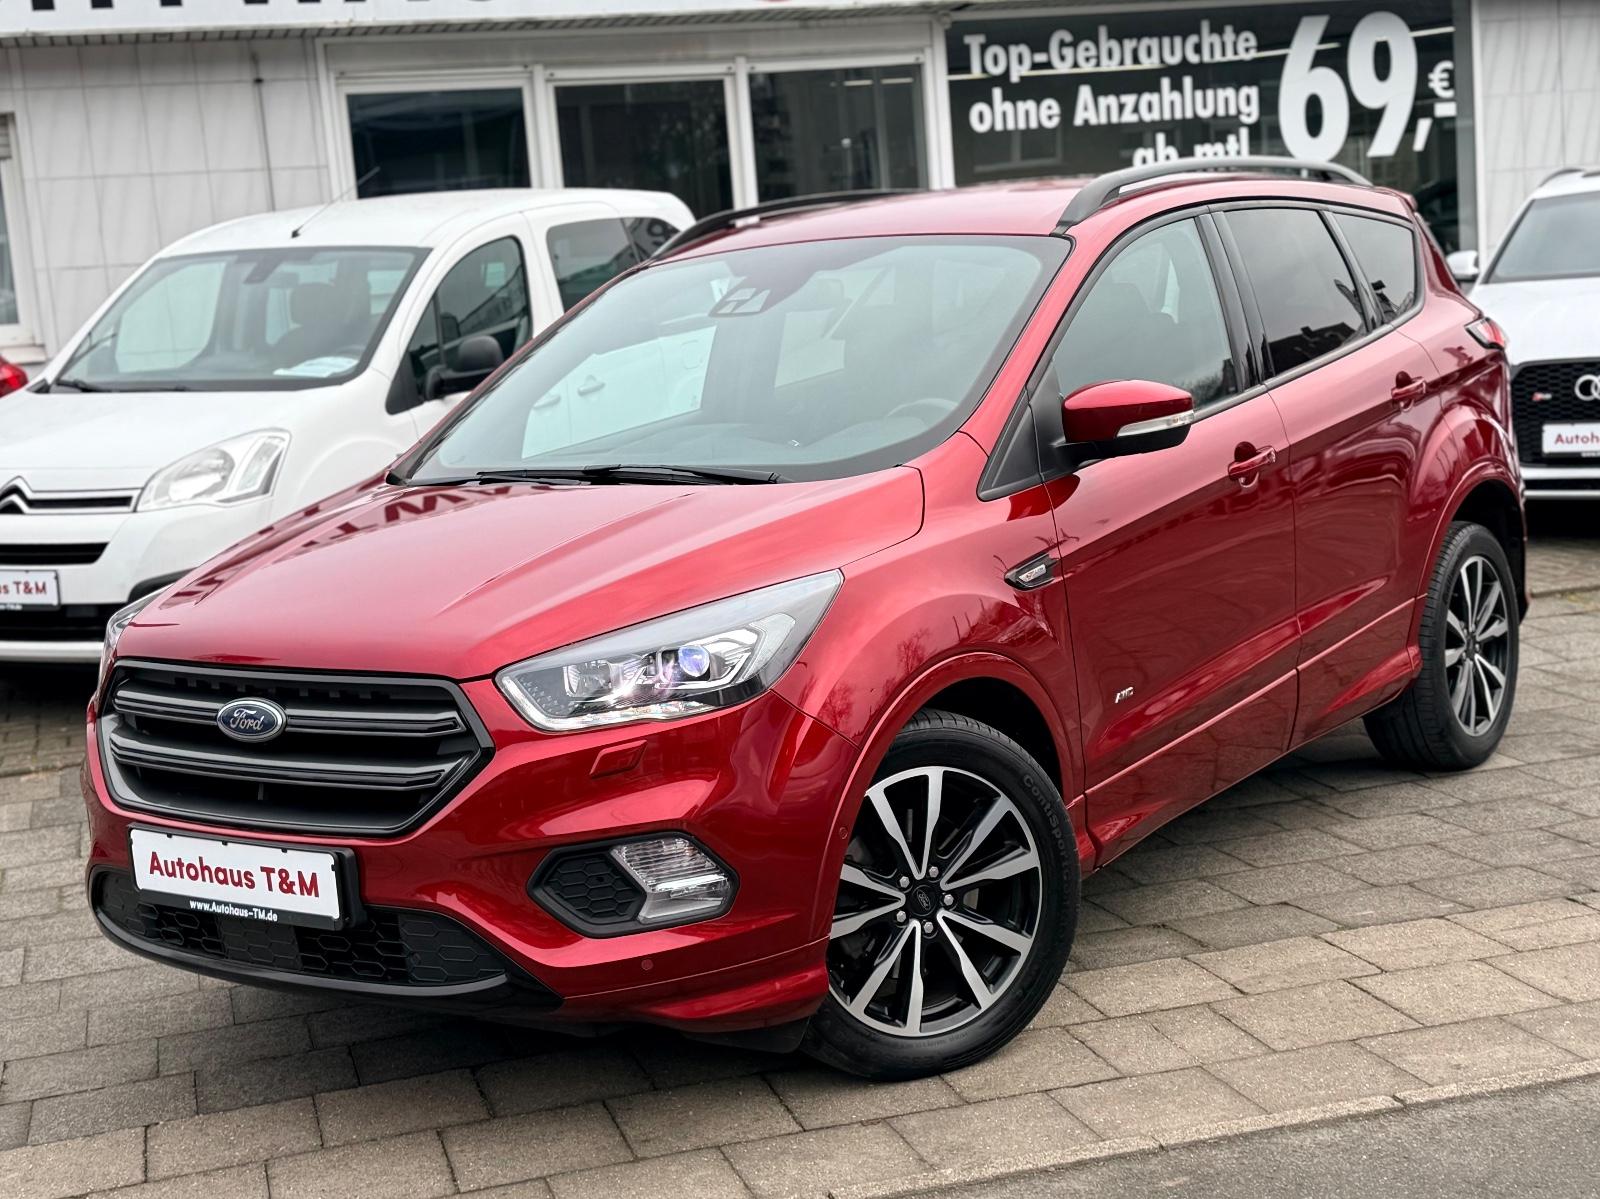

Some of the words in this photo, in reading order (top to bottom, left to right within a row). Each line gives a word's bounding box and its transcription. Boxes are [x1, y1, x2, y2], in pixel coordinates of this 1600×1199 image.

[963, 19, 1258, 83] Top-Gebrauchte
[1427, 60, 1455, 98] €
[968, 87, 1062, 134] ohne
[1073, 75, 1260, 127] Anzahlung
[13, 581, 47, 595] T&M
[229, 707, 265, 731] Ford
[149, 851, 256, 891] Autohaus
[260, 866, 320, 898] T&M
[189, 899, 279, 922] www.Autohaus-TM.de
